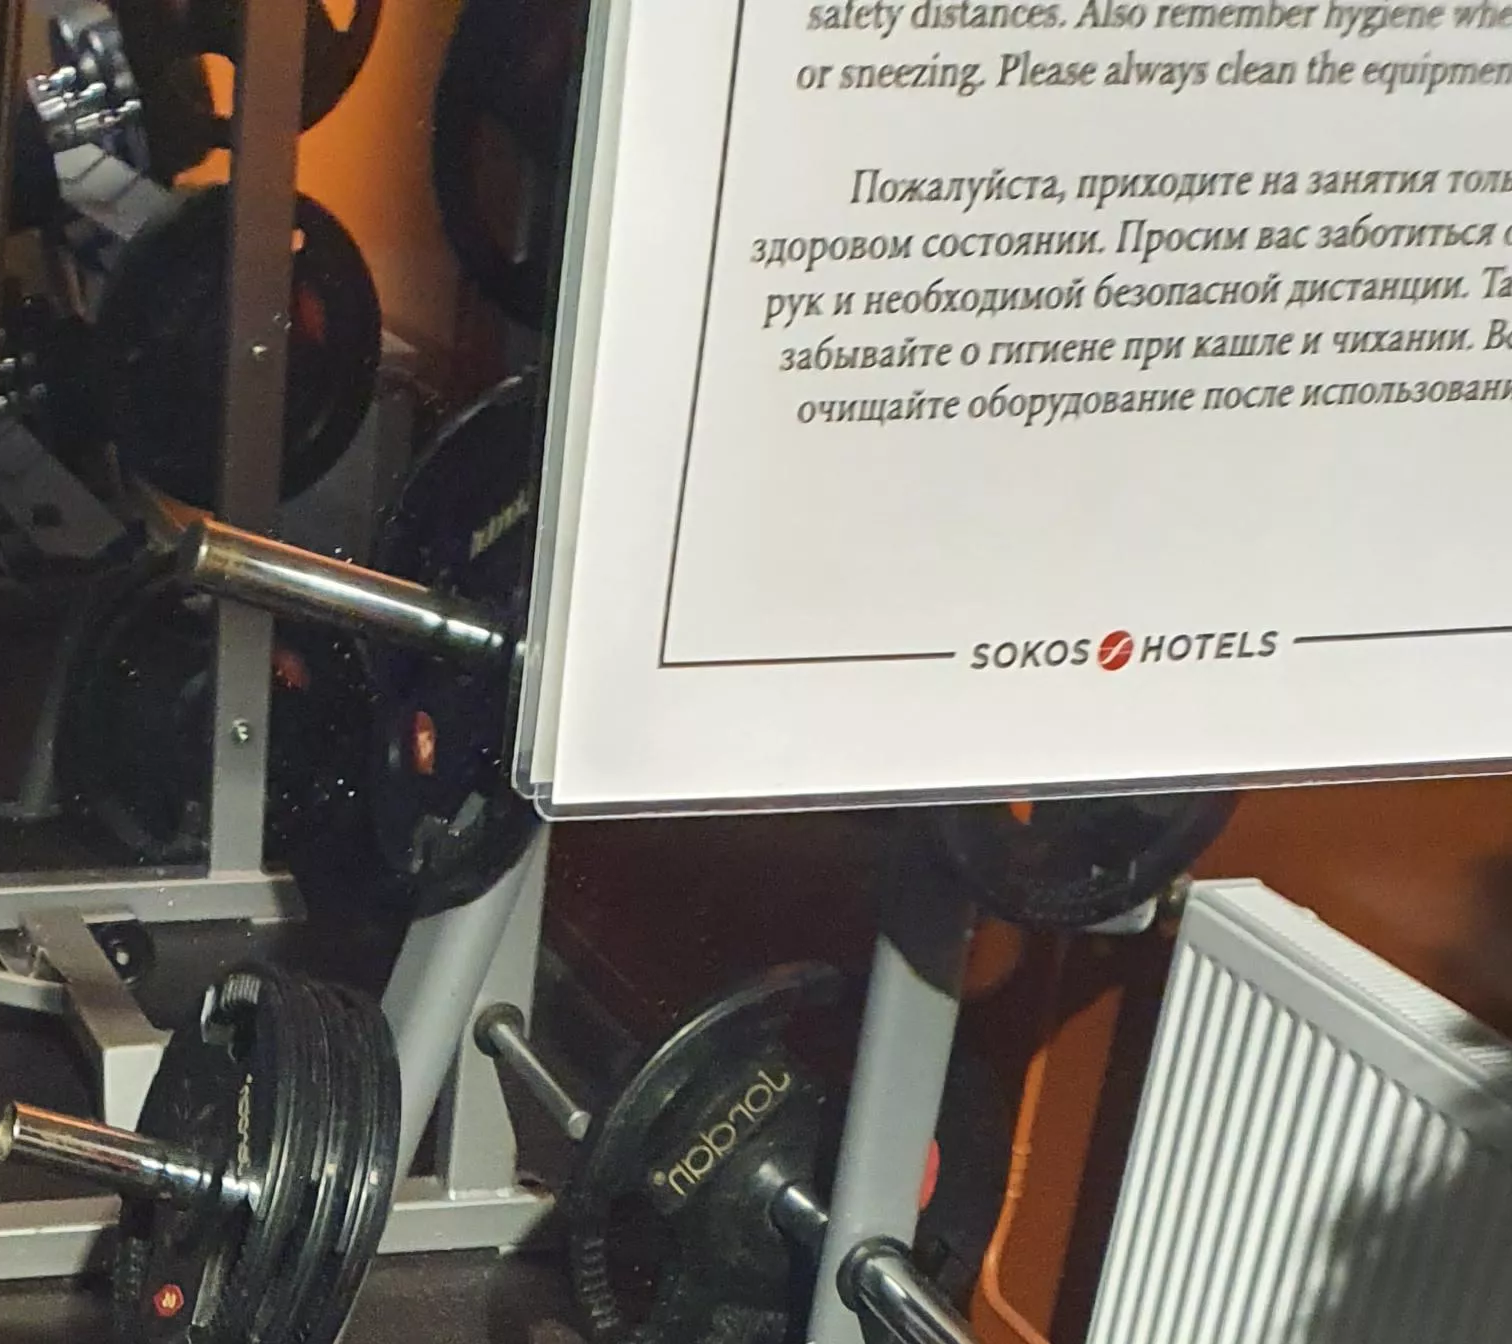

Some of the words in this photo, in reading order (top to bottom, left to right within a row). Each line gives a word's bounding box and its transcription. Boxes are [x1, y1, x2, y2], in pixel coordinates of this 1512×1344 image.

[806, 0, 904, 39] safety
[911, 0, 1067, 29] distances.
[1074, 0, 1146, 29] Also
[1153, 0, 1321, 29] remember
[1324, 0, 1445, 38] hygiene
[796, 63, 833, 90] or
[839, 52, 985, 97] sneezing.
[996, 50, 1097, 87] Please
[1104, 50, 1209, 95] always
[1216, 50, 1296, 85] clean
[1306, 50, 1355, 85] the
[850, 167, 1066, 213] Пожалуйста,
[1076, 170, 1252, 209] приходите
[1260, 170, 1299, 195] на
[1306, 168, 1441, 194] занятия
[750, 234, 914, 272] здоровом
[922, 230, 1105, 258] состоянии.
[1116, 218, 1249, 263] Просим
[1256, 226, 1310, 250] вас
[1315, 213, 1497, 248] заботиться
[762, 291, 824, 329] рук
[832, 292, 855, 315] и
[863, 277, 1086, 318] необходимой
[1093, 273, 1283, 307] безопасной
[1285, 275, 1469, 309] дистанции.
[780, 335, 952, 371] забывайте
[960, 342, 980, 366] о
[988, 337, 1116, 365] гигиене
[1122, 335, 1186, 370] при
[1192, 332, 1294, 358] кашле
[1299, 331, 1325, 356] и
[1332, 327, 1475, 354] чихании.
[1481, 318, 1512, 350] В
[797, 390, 961, 426] очищайте
[968, 383, 1195, 427] оборудование
[1202, 384, 1294, 410] после
[970, 638, 1091, 670] SOKOS
[1140, 630, 1279, 663] HOTELS
